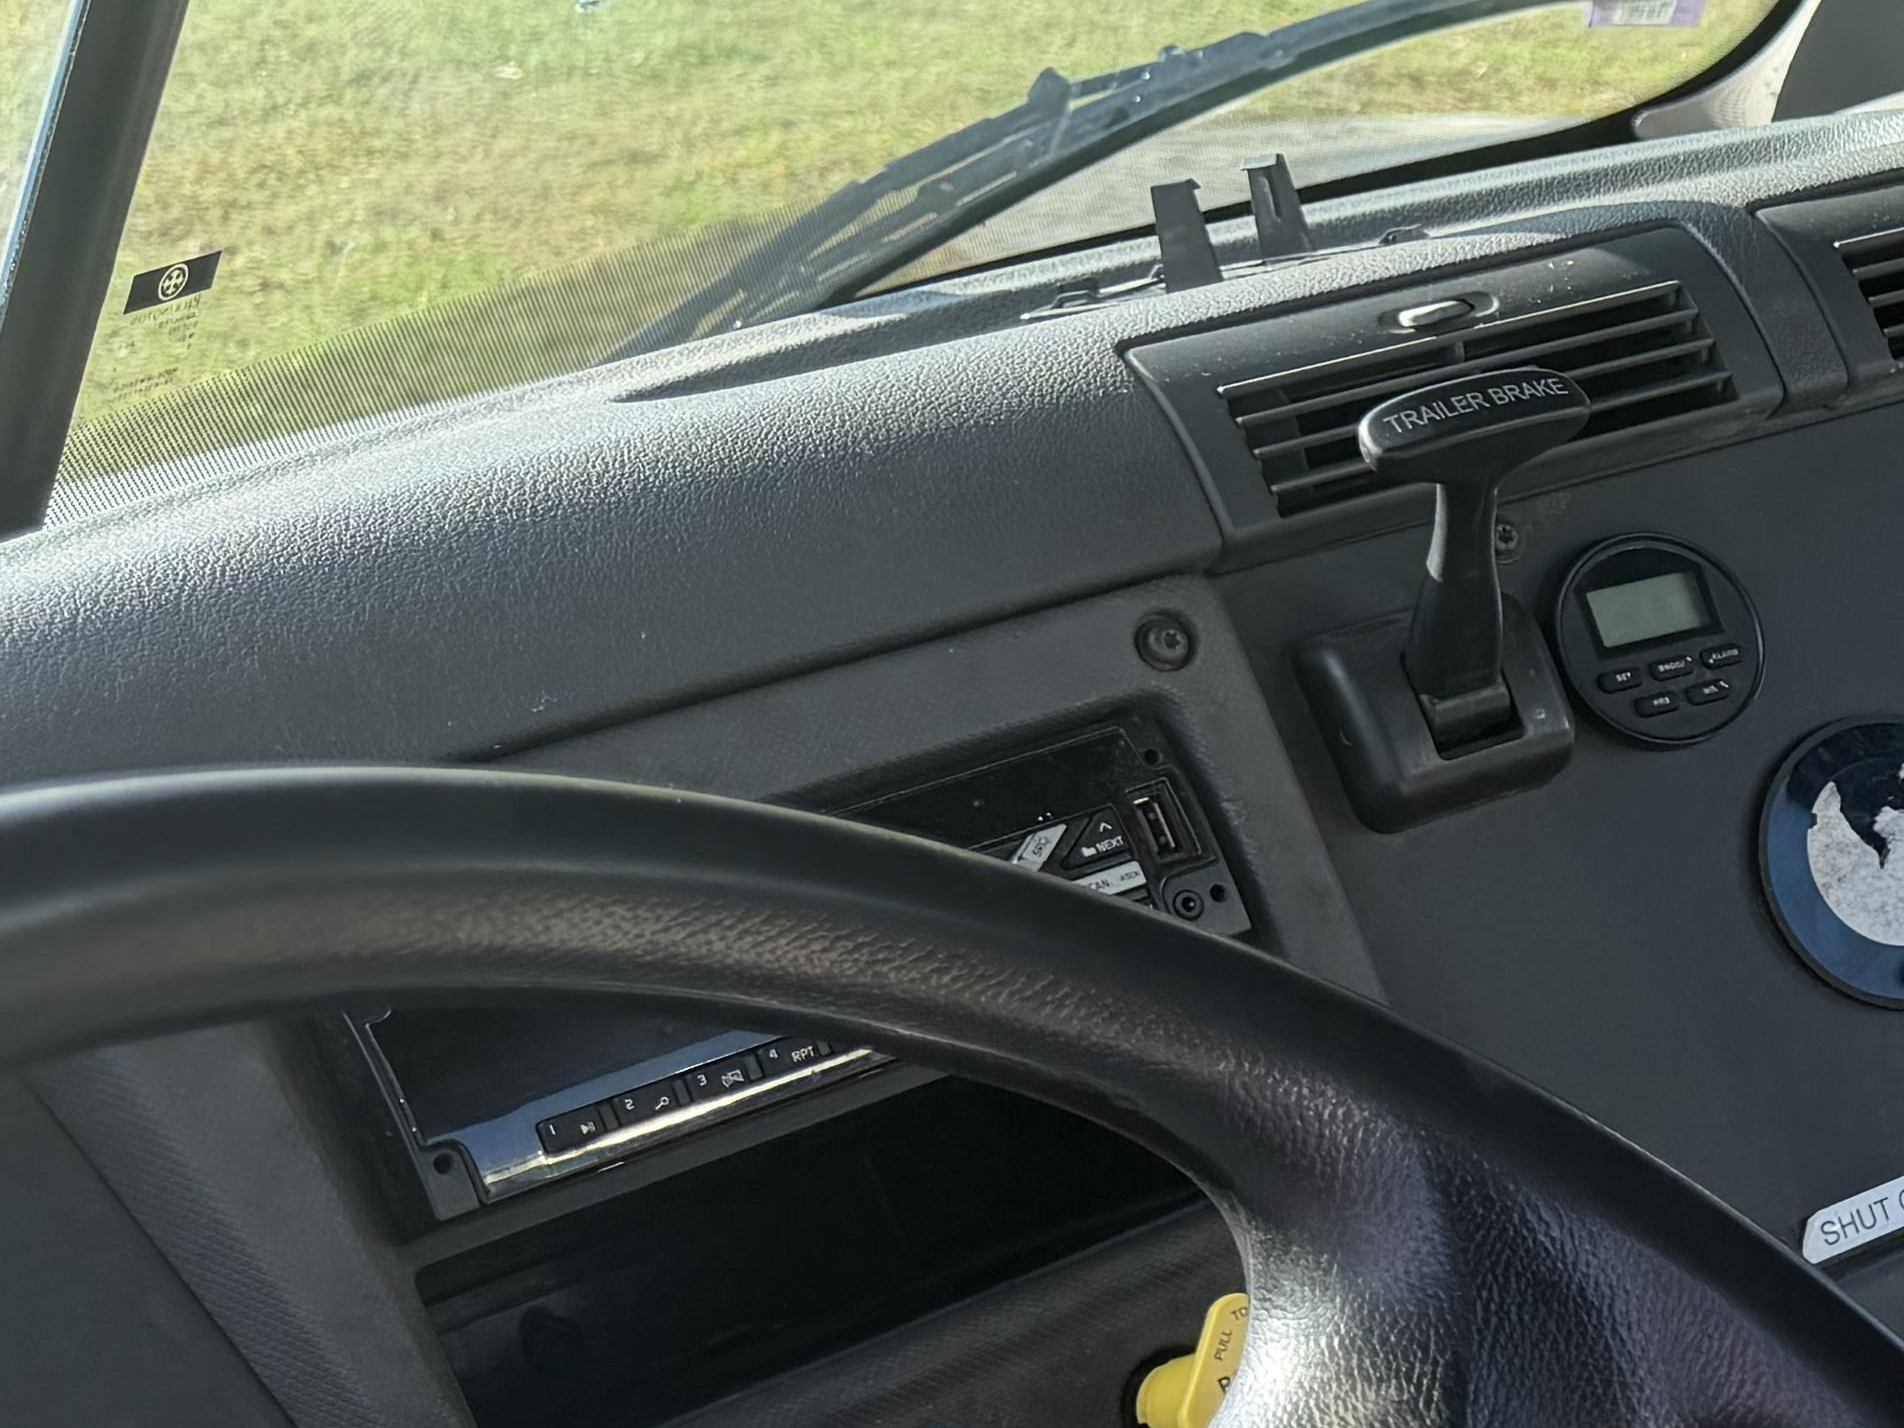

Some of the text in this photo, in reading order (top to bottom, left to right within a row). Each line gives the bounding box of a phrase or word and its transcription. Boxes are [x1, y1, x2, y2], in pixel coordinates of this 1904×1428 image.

[1383, 378, 1569, 433] TRAILER BRAKE
[1096, 835, 1125, 853] NEXT
[791, 1045, 816, 1063] RPT
[623, 1098, 635, 1111] 2
[1820, 1198, 1892, 1246] SHUT
[1214, 1329, 1233, 1362] PULL
